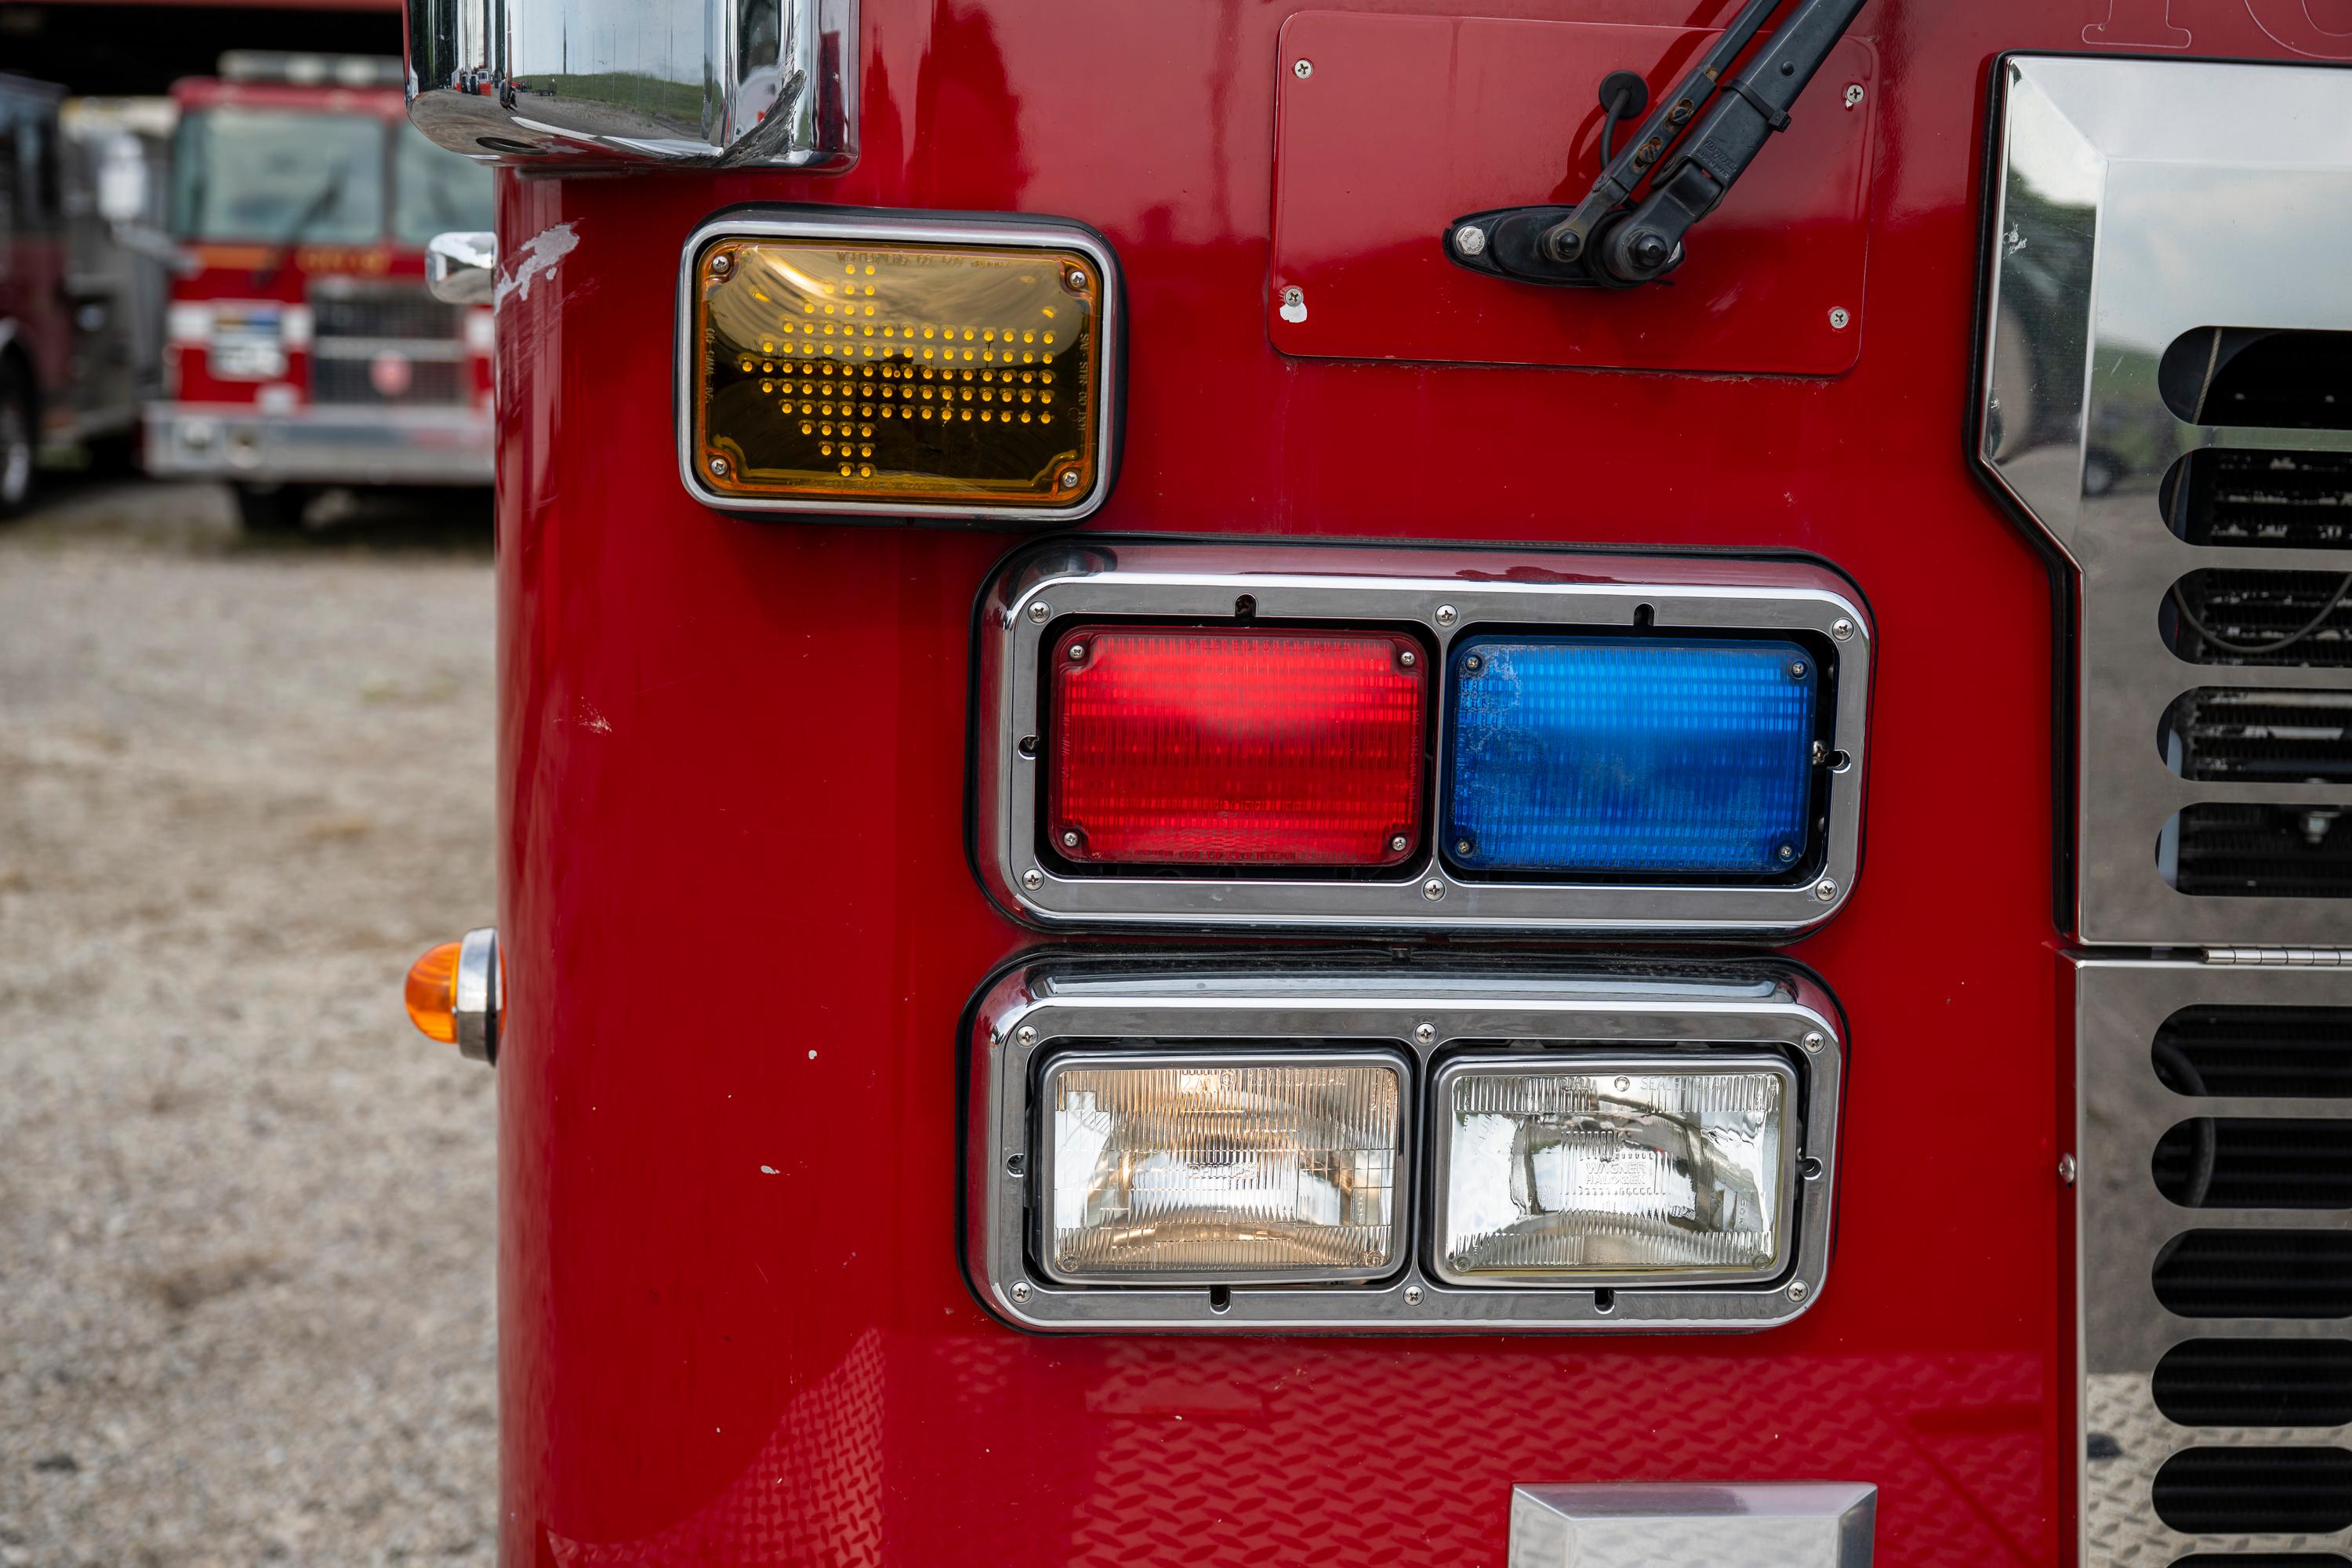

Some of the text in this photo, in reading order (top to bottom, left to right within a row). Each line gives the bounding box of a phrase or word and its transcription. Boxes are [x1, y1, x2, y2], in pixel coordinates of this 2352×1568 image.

[1639, 1076, 1689, 1091] SEALED
[1693, 1076, 1729, 1091] BEAM
[1585, 1161, 1646, 1174] WAGNER
[1585, 1174, 1646, 1185] HALOGEN
